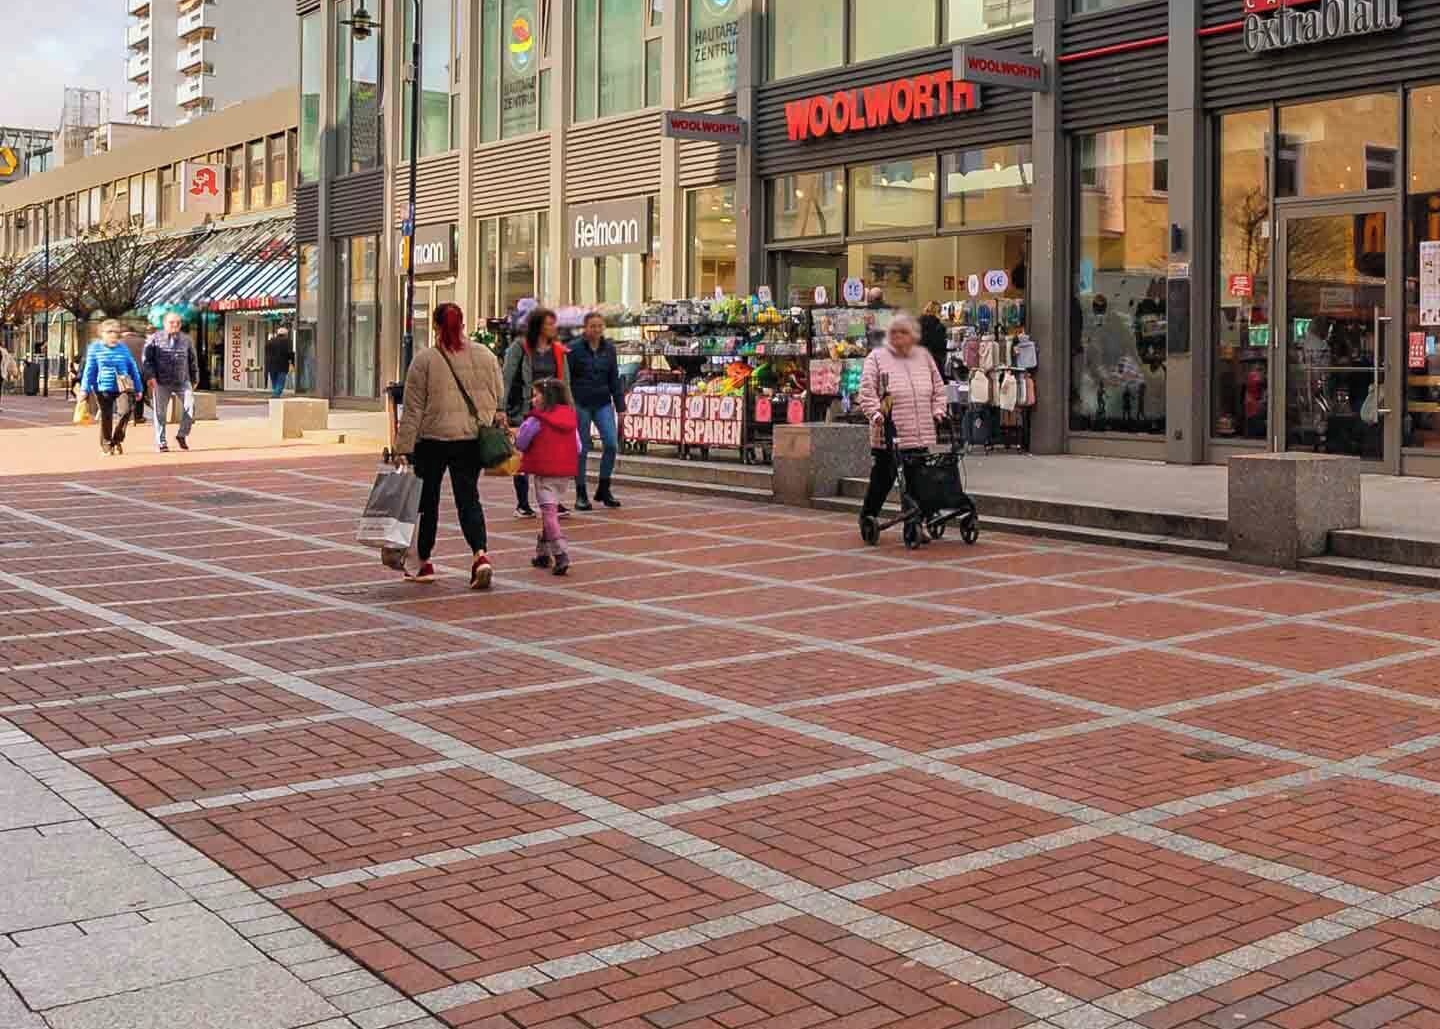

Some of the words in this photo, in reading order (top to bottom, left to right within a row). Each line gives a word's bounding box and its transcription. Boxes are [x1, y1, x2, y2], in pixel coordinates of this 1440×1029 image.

[968, 56, 1041, 80] WOOLWORTH
[784, 70, 976, 141] WOOLWORTH
[671, 118, 740, 135] WOOLWORTH
[232, 324, 242, 383] APOTHEKE
[624, 416, 681, 441] SPAREN
[685, 420, 741, 445] SPAREN
